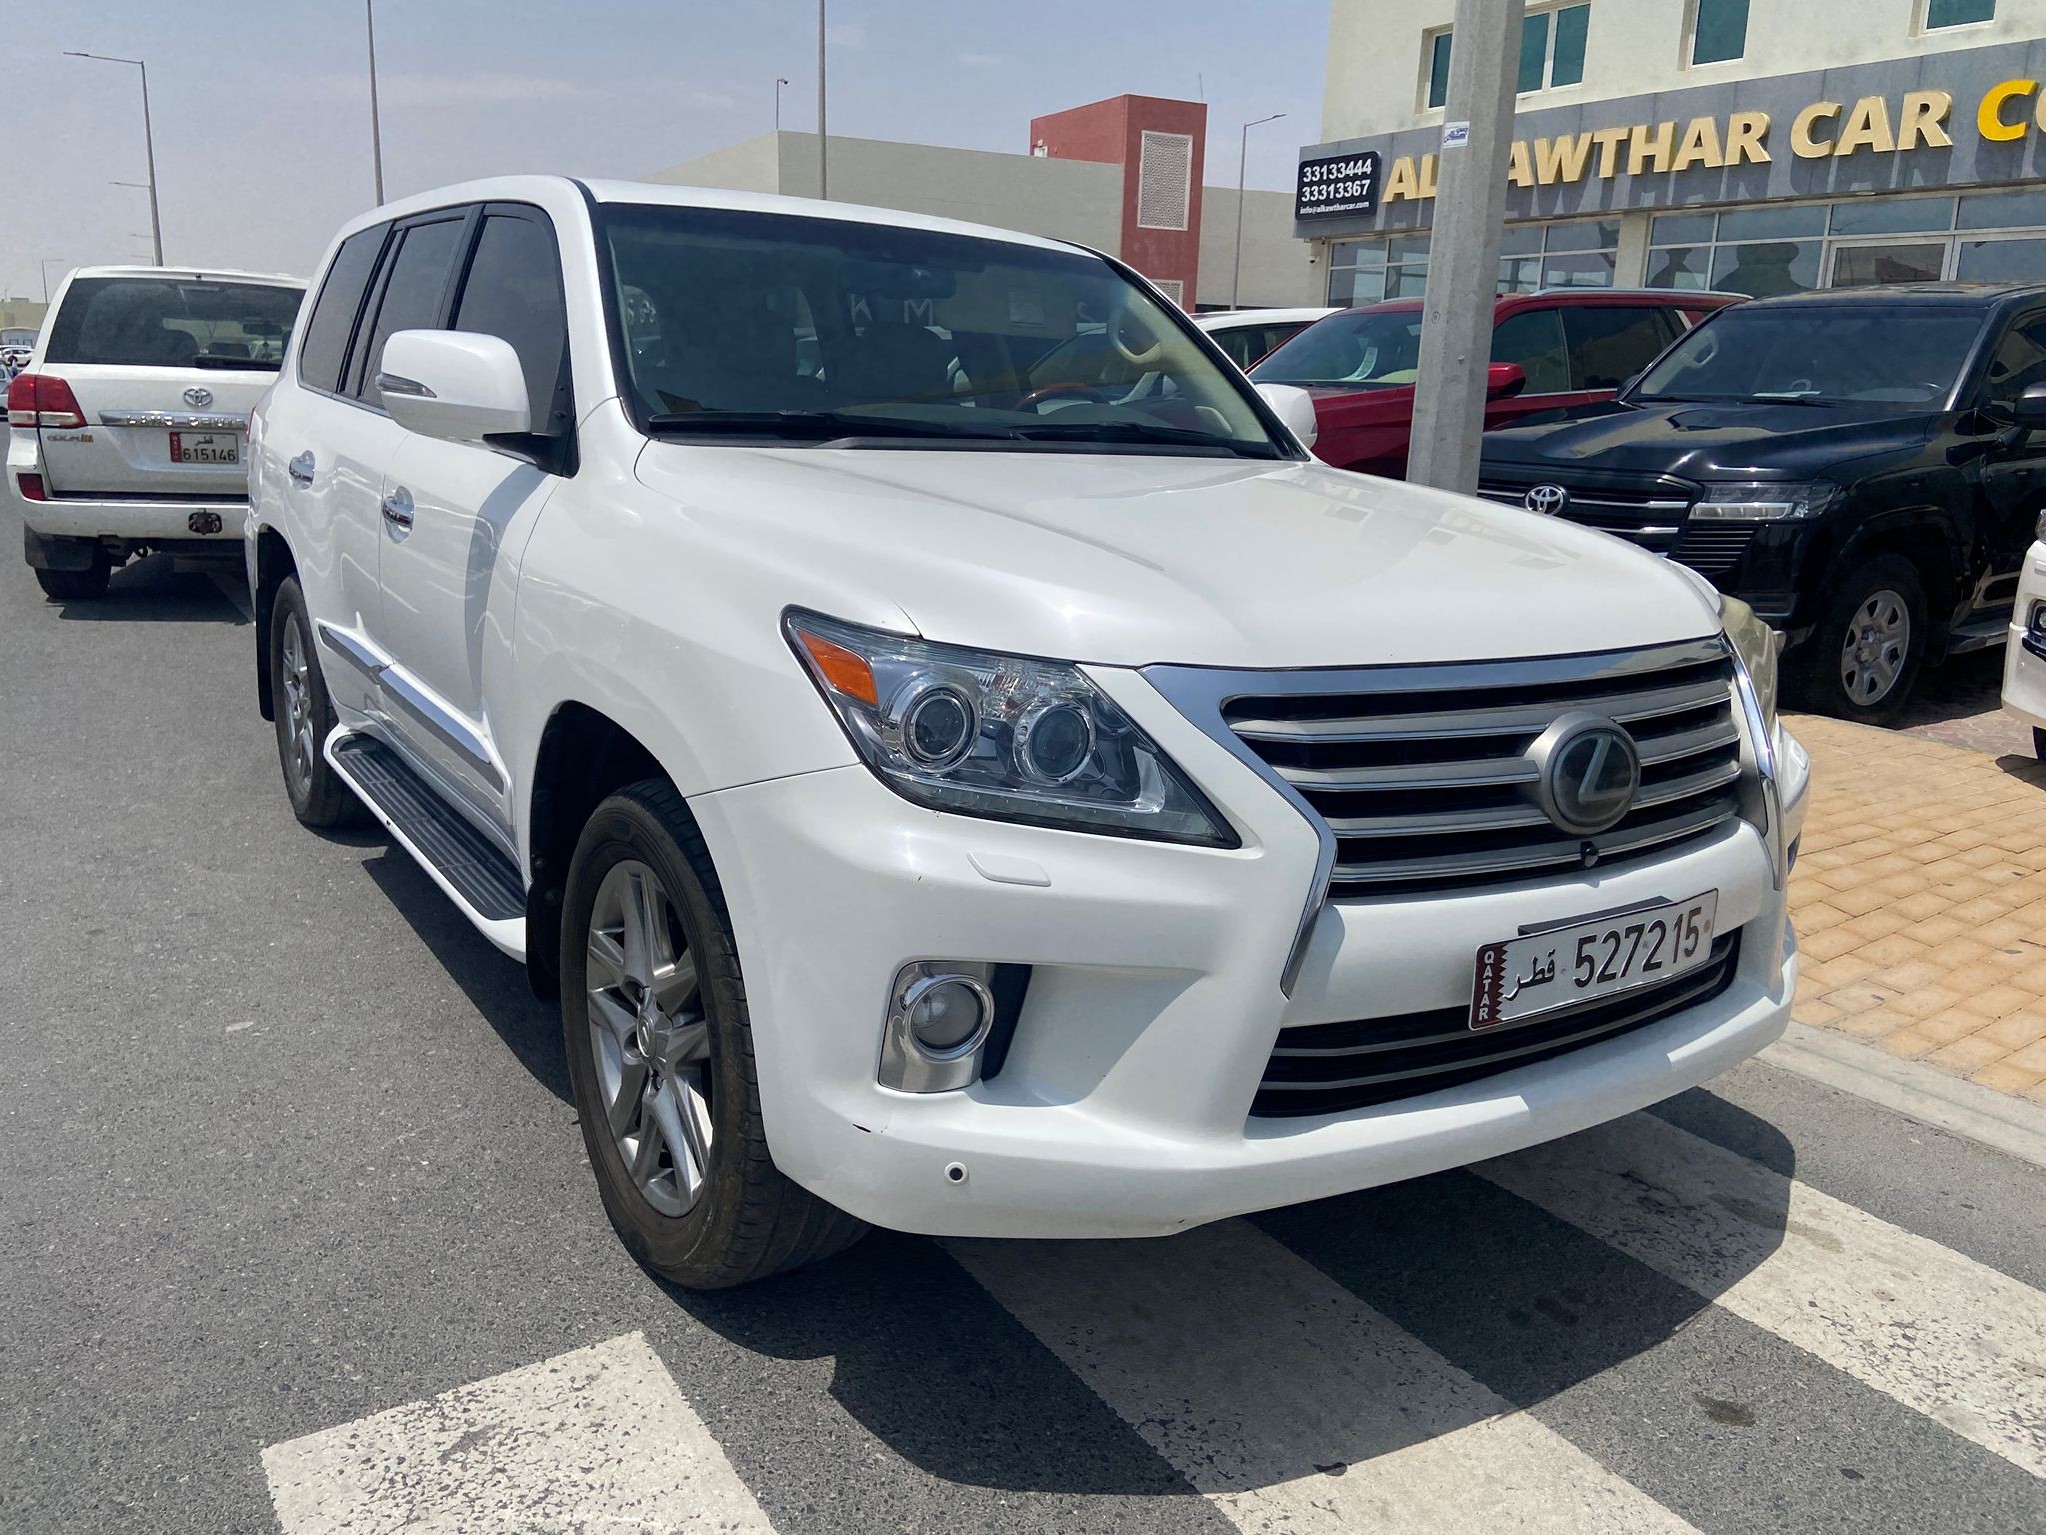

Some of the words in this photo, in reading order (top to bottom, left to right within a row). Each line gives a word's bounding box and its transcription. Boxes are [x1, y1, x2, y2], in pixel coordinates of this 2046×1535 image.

[1508, 112, 1772, 187] AWTHAR
[1790, 90, 1953, 159] CAR
[1977, 78, 2046, 142] C
[1302, 158, 1372, 183] 33133444
[1300, 201, 1370, 215] info@alkawtharcar.com
[1301, 179, 1371, 202] 33313367
[182, 447, 236, 461] 615146
[1572, 906, 1702, 988] 527215
[1478, 950, 1495, 1021] QATAR
[1502, 948, 1556, 1002] قطر
